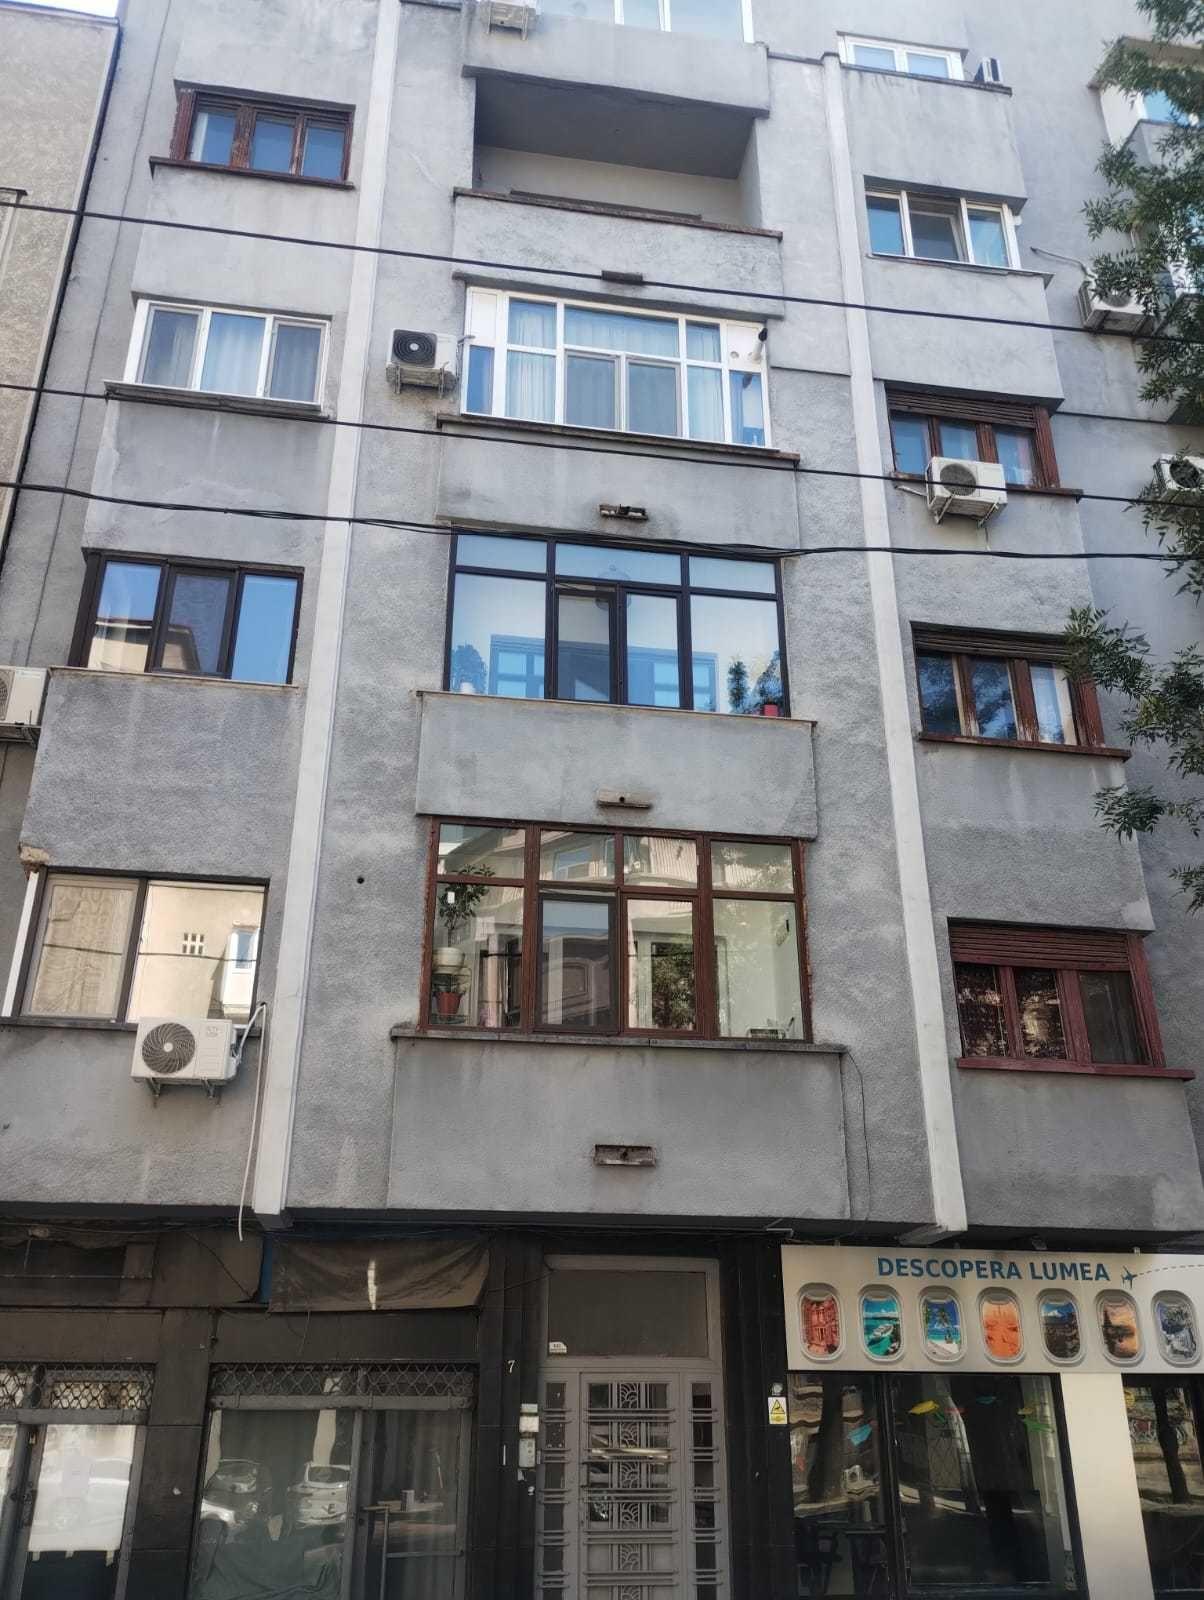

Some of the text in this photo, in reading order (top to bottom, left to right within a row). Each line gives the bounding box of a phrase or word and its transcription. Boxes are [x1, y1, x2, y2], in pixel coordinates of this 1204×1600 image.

[877, 1257, 1111, 1281] DESCOPERA LUMEA
[507, 1360, 516, 1374] 7
